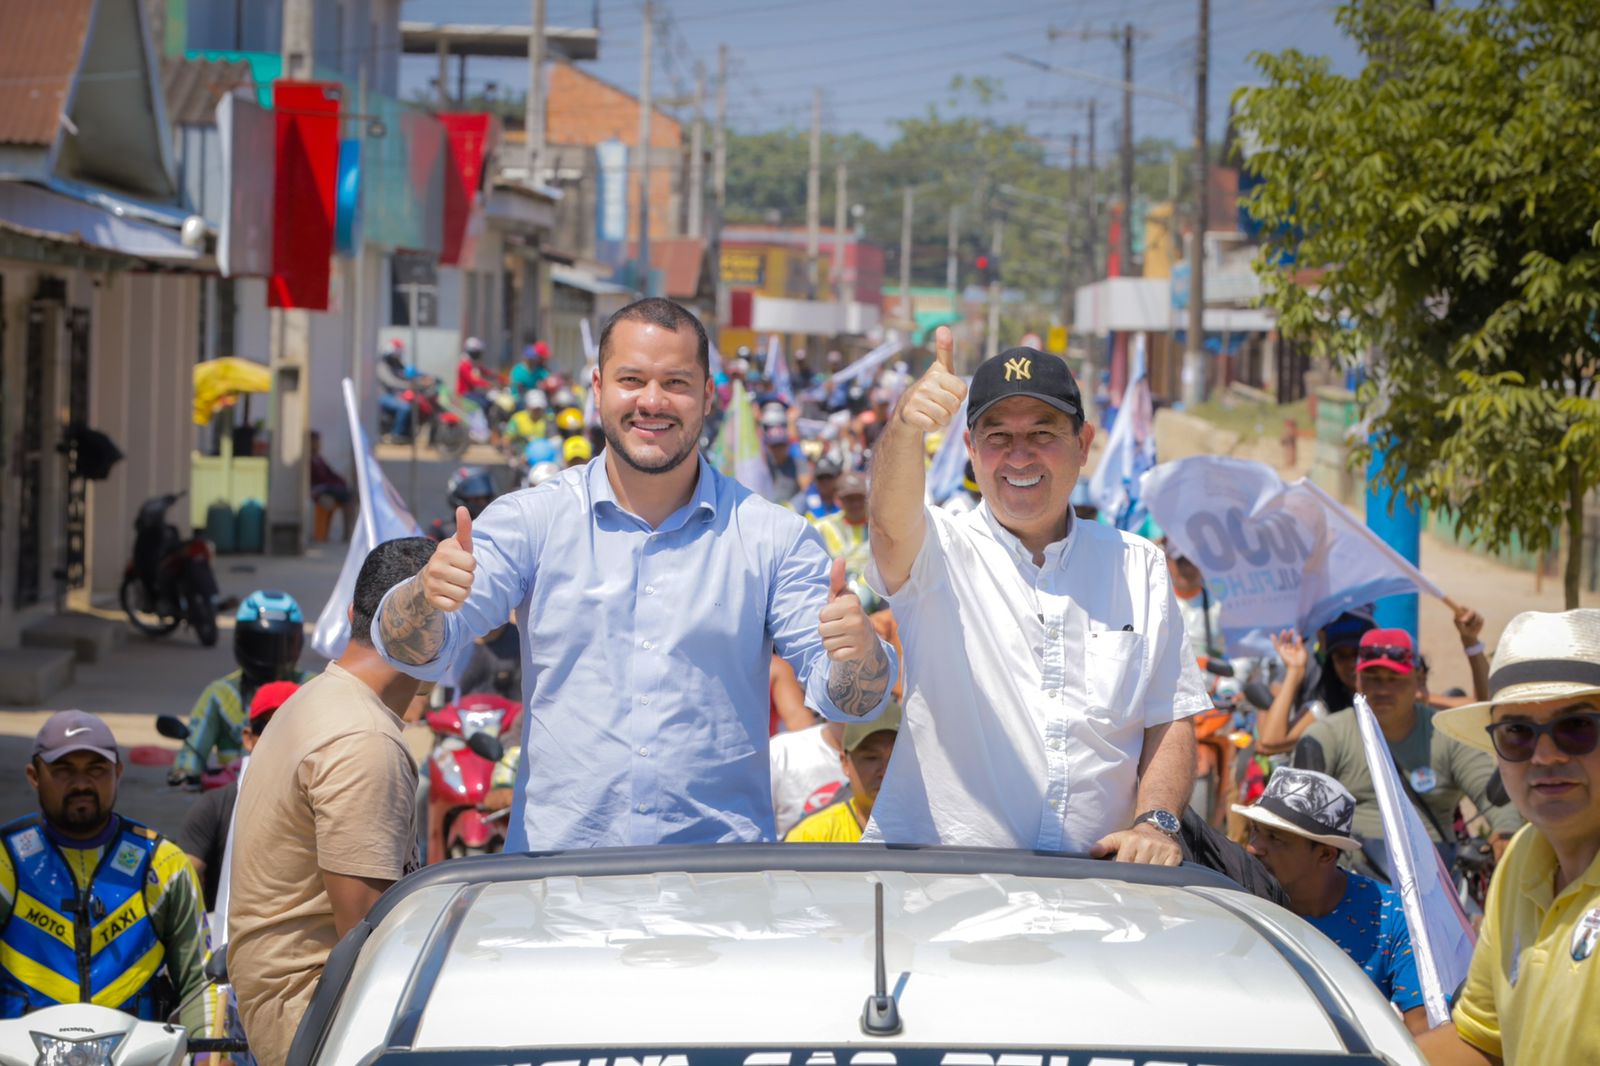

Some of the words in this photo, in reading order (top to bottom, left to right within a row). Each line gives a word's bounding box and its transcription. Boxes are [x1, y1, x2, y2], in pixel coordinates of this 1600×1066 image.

[1003, 356, 1032, 382] NY
[25, 907, 66, 937] MOTO
[100, 908, 138, 943] TAXI
